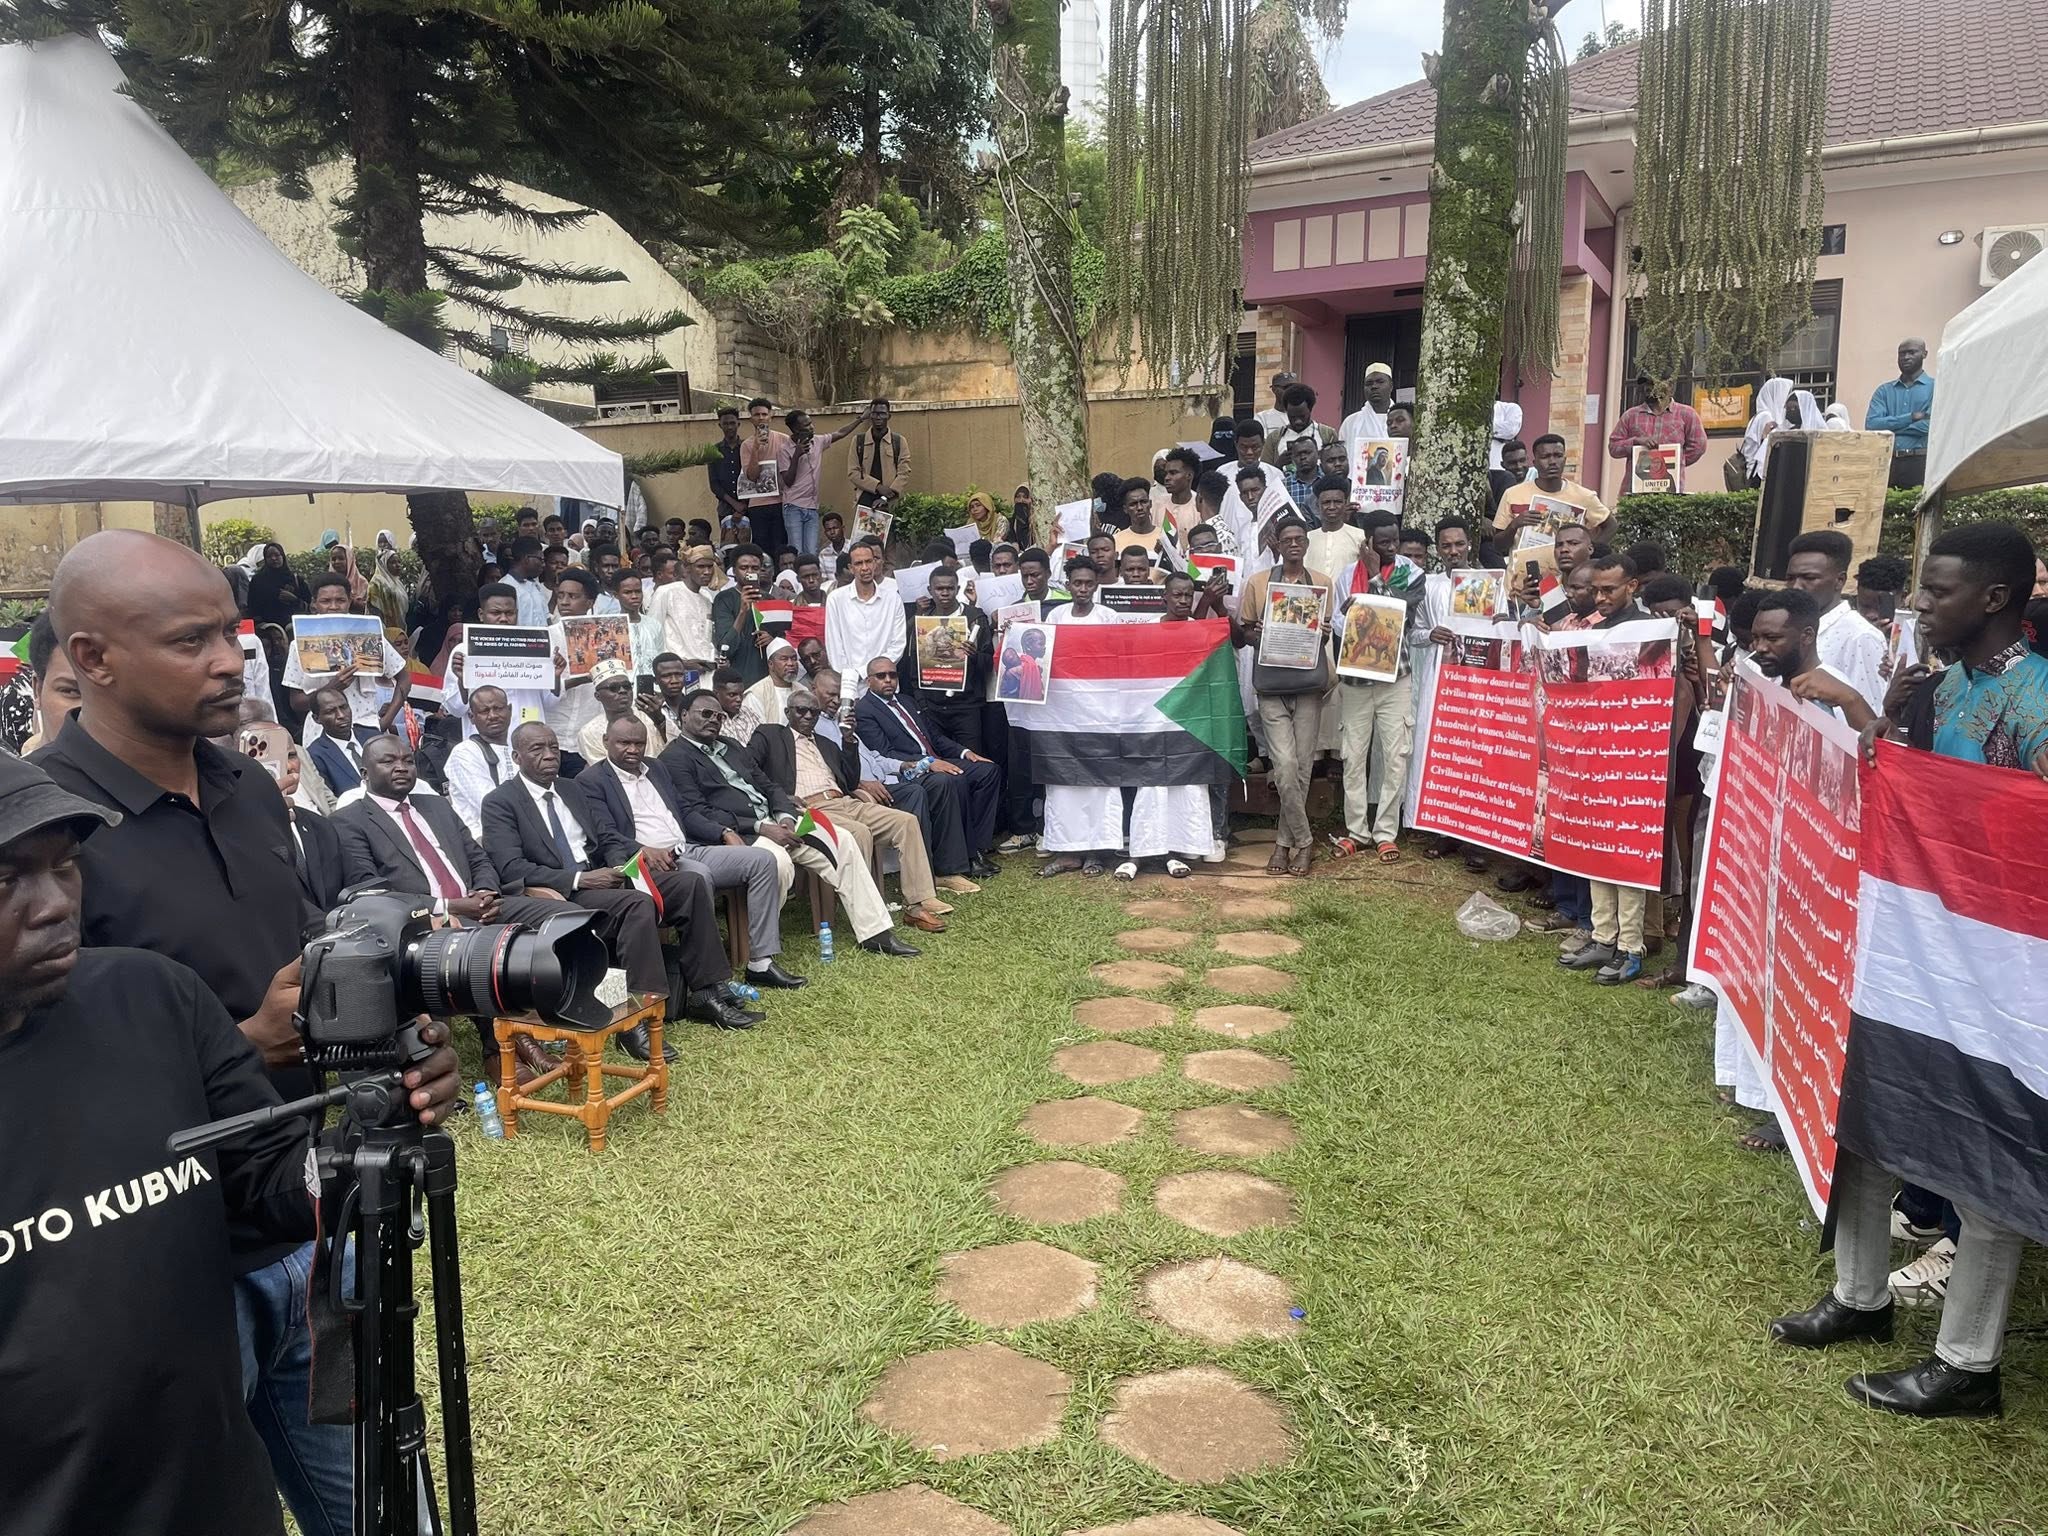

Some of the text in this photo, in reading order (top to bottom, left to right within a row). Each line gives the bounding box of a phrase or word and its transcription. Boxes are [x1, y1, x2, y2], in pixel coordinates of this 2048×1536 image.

[1444, 670, 1466, 680] Videos
[1468, 674, 1488, 684] show
[1468, 692, 1484, 700] men
[1486, 694, 1504, 706] being
[1600, 694, 1628, 709] فيديو
[1630, 694, 1662, 709] مقطع
[1470, 707, 1478, 716] of
[1479, 708, 1495, 719] RSF
[1611, 720, 1648, 732] تعرضوا
[1477, 727, 1504, 739] women,
[1505, 731, 1527, 743] children,
[1433, 734, 1448, 744] the
[1448, 737, 1471, 749] elderly
[1495, 745, 1502, 754] El
[1519, 750, 1531, 760] have
[1576, 746, 1596, 757] الدعم
[1599, 743, 1636, 758] مليشيا
[1638, 747, 1652, 758] من
[1431, 749, 1451, 760] been
[1430, 765, 1463, 779] Civilians
[1464, 772, 1470, 780] in
[1472, 773, 1479, 783] El
[1498, 781, 1509, 790] are
[1510, 782, 1526, 796] facing
[1580, 769, 1590, 780] من
[1591, 770, 1622, 783] الفارين
[1625, 770, 1648, 781] مئات
[1426, 780, 1516, 809] threat of genocide, while the
[1619, 797, 1656, 808] والاطفال
[1424, 796, 1470, 814] international
[1471, 805, 1491, 820] silence
[1492, 812, 1497, 821] is
[1502, 815, 1526, 832] message
[1566, 812, 1591, 828] الجماعية
[1421, 811, 1436, 822] the
[1437, 813, 1458, 829] killers
[1465, 822, 1491, 838] continue
[1492, 827, 1502, 840] the
[1501, 833, 1528, 848] genocide
[1592, 817, 1614, 830] الابادة
[1616, 822, 1639, 831] خطر
[1591, 840, 1616, 853] للقتلة
[1617, 843, 1643, 858] رسالة
